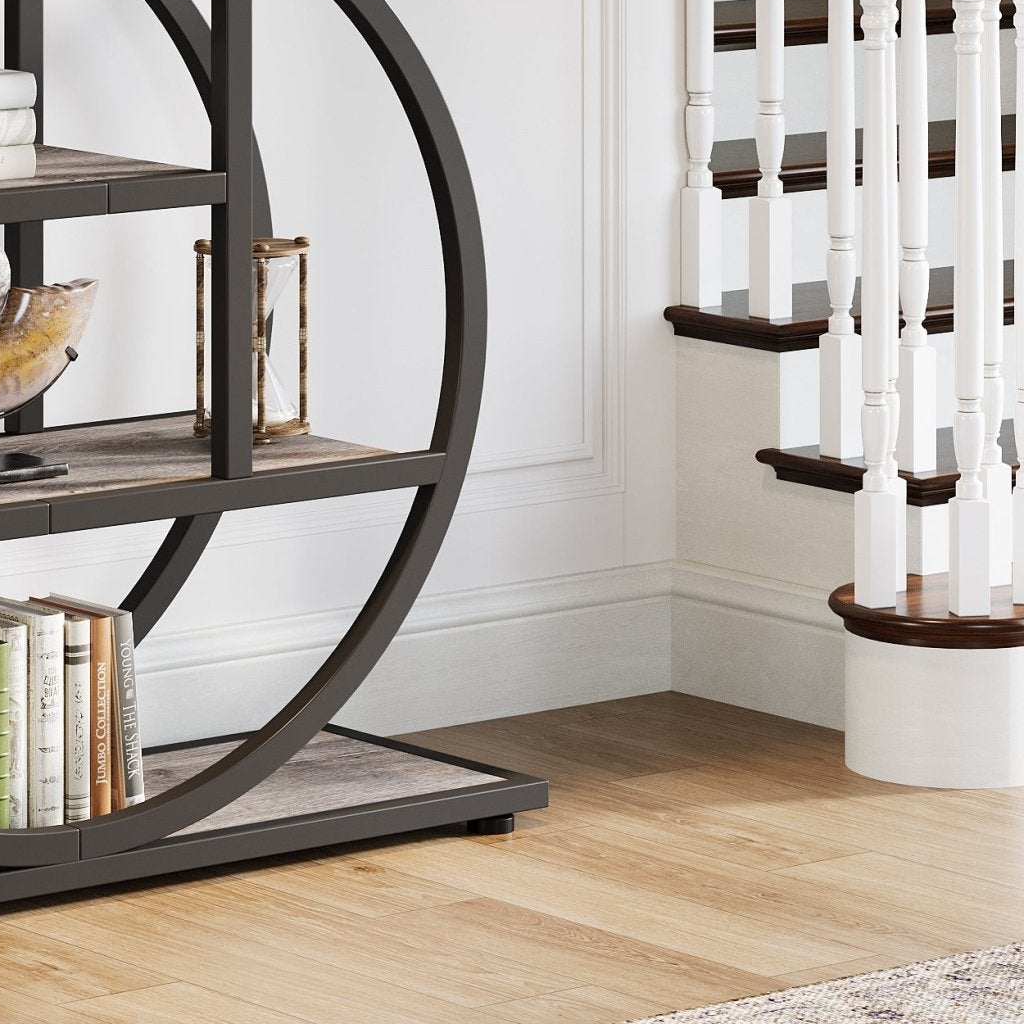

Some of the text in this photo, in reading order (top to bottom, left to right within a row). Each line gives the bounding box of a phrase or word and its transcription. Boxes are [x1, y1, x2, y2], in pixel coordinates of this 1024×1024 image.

[119, 638, 141, 780] YOUNG THE SHACK
